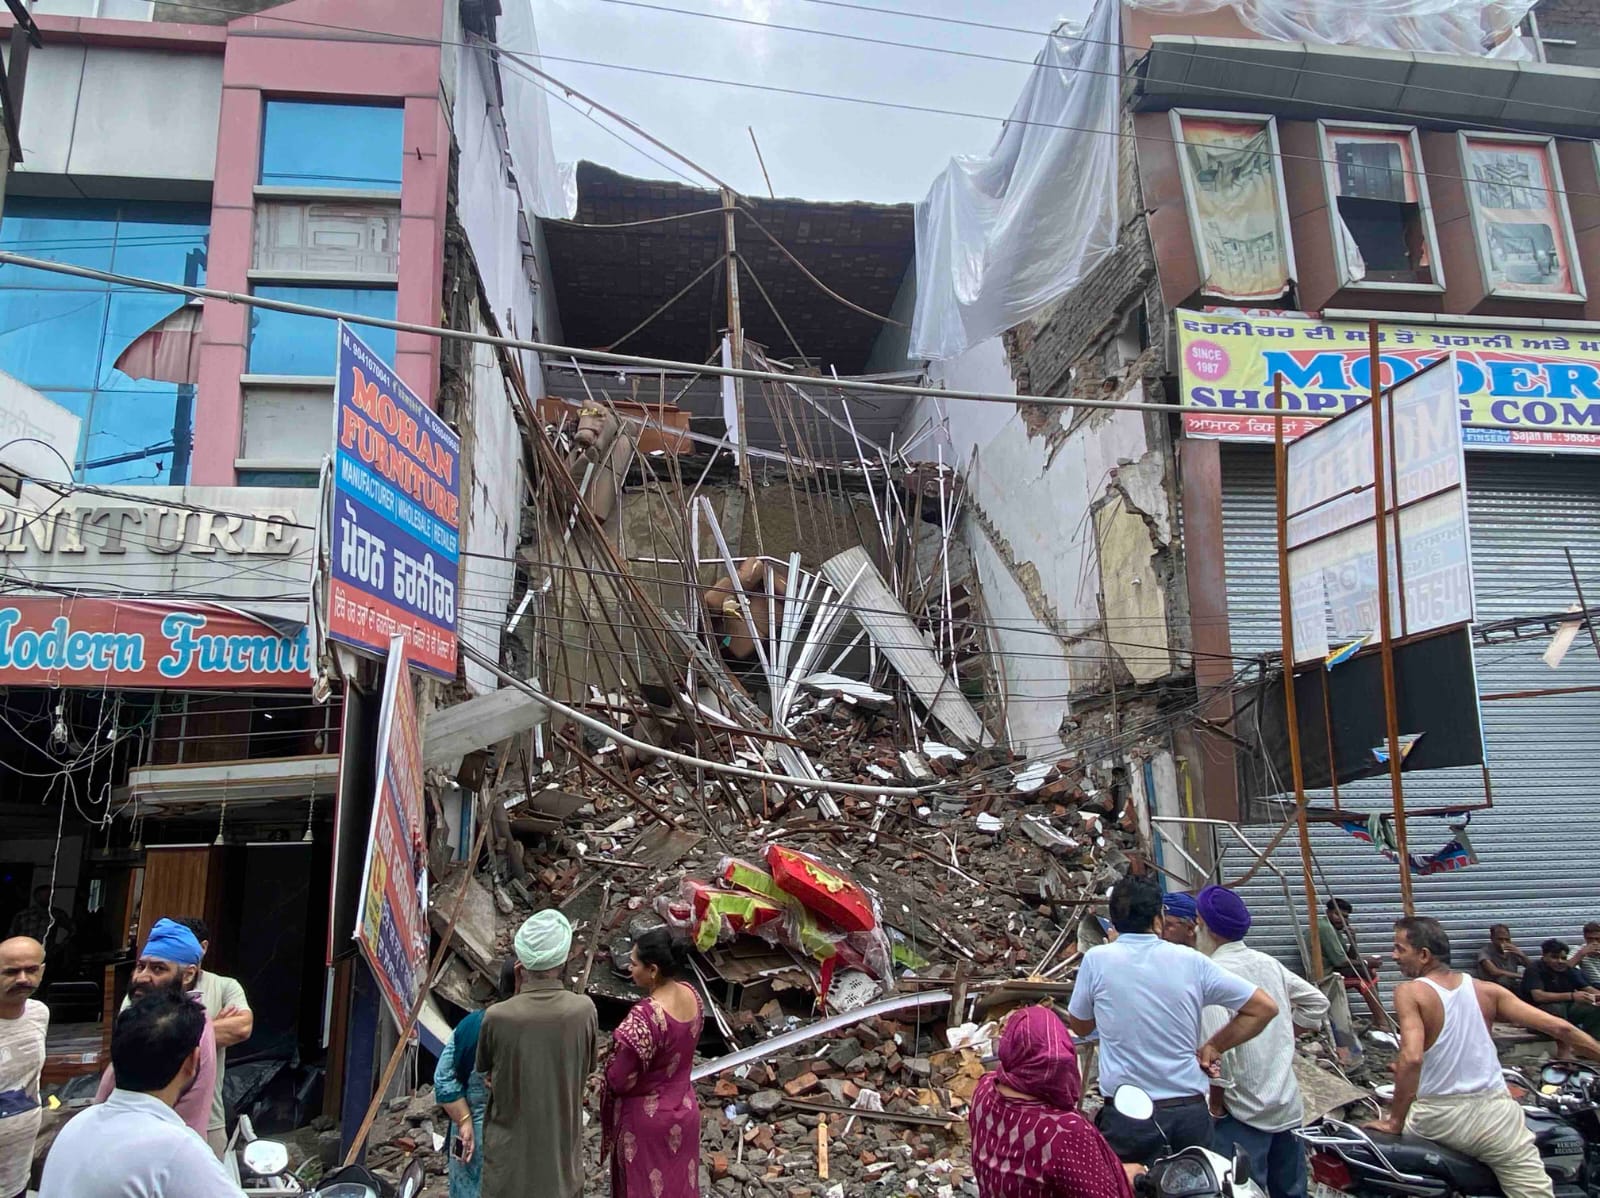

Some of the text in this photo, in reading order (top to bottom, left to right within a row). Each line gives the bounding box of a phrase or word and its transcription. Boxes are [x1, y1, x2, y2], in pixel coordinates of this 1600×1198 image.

[1192, 346, 1222, 361] SINCE
[1303, 325, 1336, 341] ਦੀ
[1196, 360, 1219, 374] 1987
[352, 366, 454, 487] MOHAN
[341, 404, 459, 529] FURNITURE
[0, 506, 300, 555] NITURE
[342, 456, 457, 555] MANUFACTURER WHOLESALE RETAILER
[393, 547, 455, 624] ਫਰਨੀਚਰ
